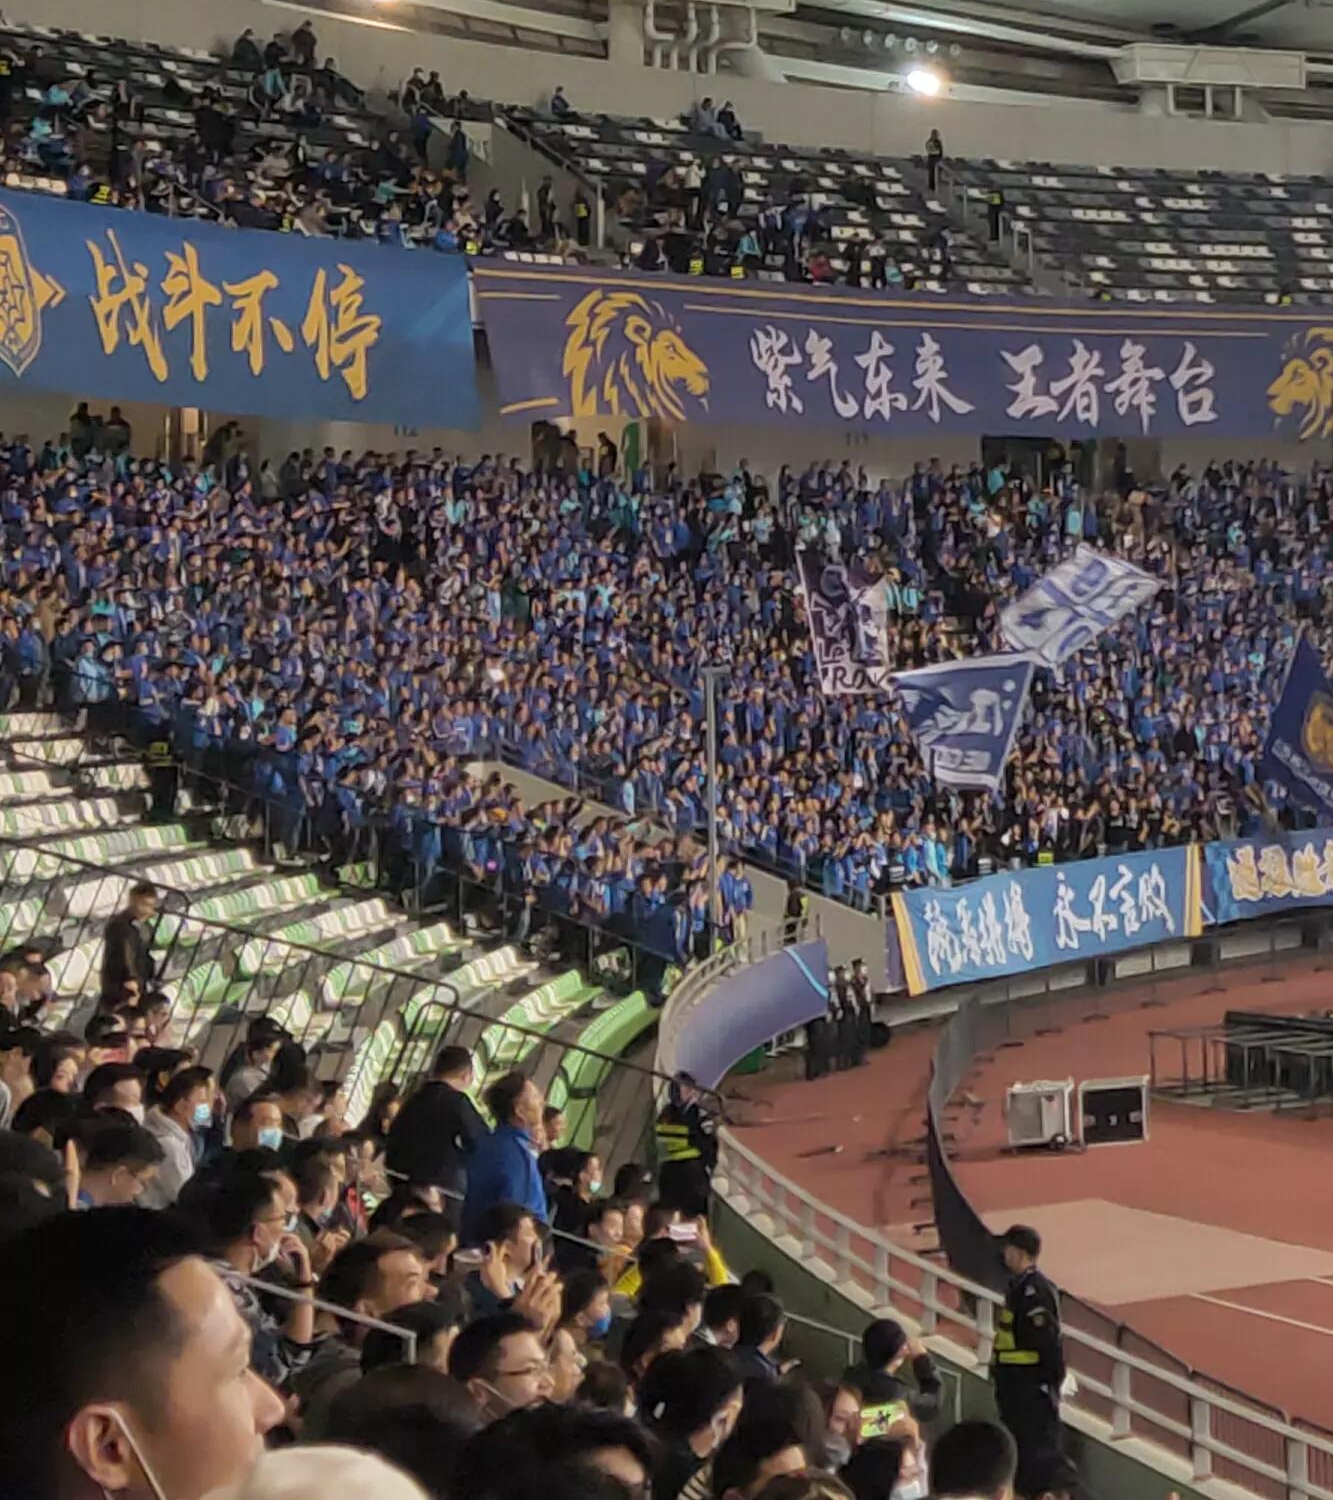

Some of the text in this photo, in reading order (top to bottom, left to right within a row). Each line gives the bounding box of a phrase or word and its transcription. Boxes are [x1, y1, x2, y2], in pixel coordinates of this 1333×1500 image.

[86, 227, 382, 400] 战斗不停
[751, 325, 1219, 434] 紫气东来 王者舞台
